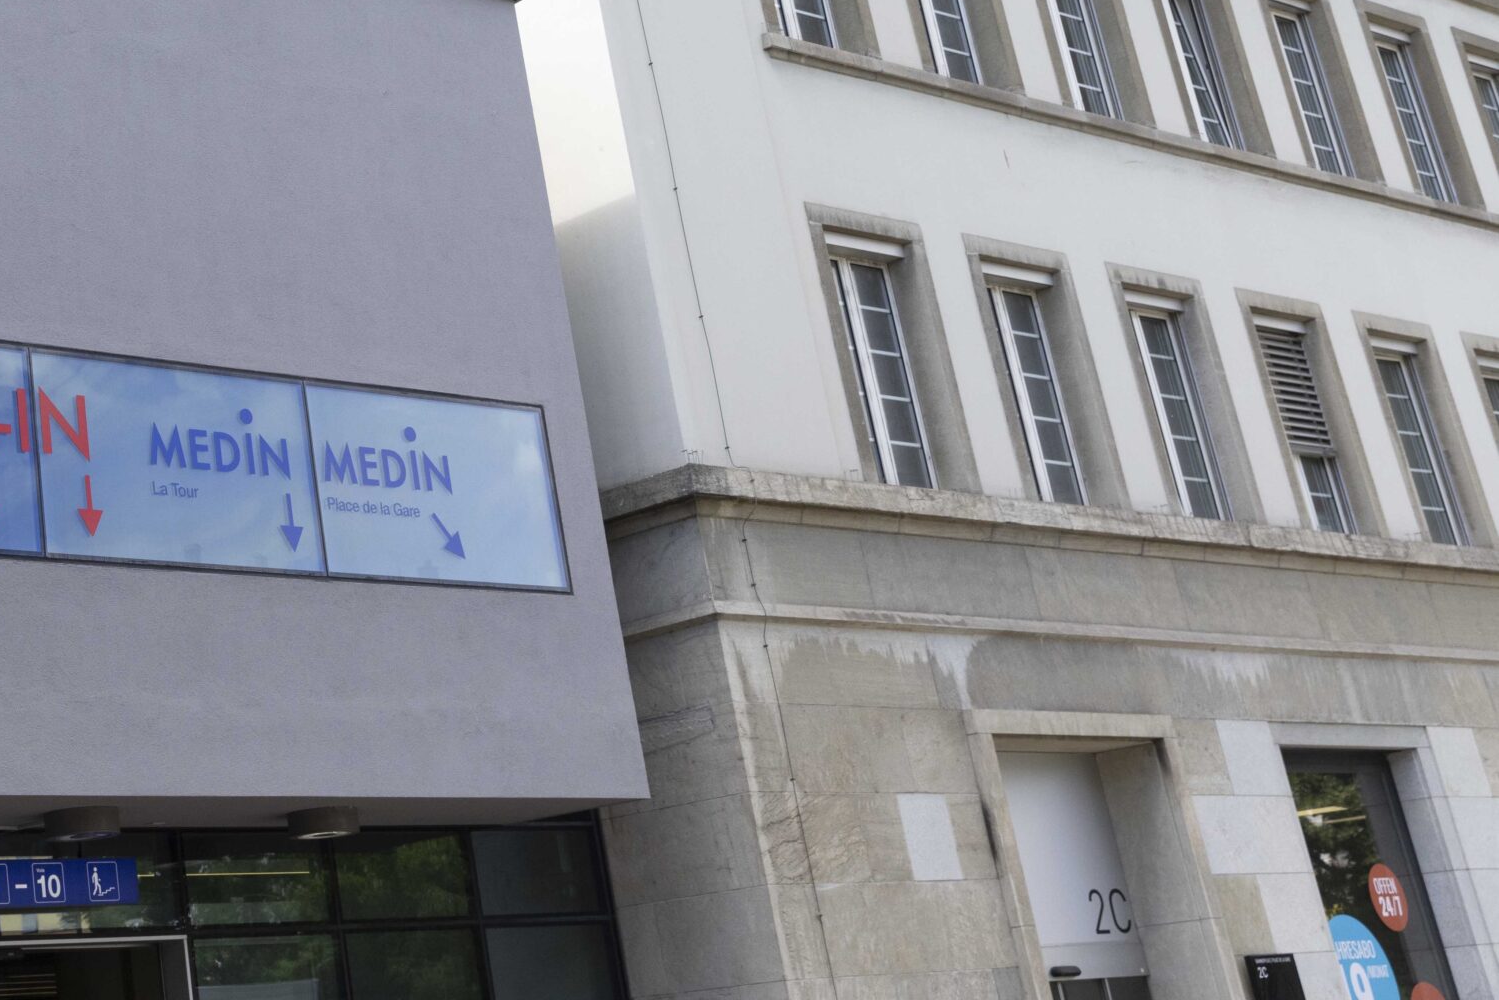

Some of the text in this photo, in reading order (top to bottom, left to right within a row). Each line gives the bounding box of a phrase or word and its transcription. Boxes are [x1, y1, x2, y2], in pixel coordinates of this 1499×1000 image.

[150, 408, 291, 481] MEDIN
[324, 426, 453, 496] MEDIN
[151, 481, 199, 500] La Tour
[326, 496, 421, 519] Place de la Gare
[37, 874, 61, 898] 10
[1373, 877, 1398, 895] OFFEN
[1088, 888, 1131, 934] 2C
[1378, 895, 1403, 917] 24/7
